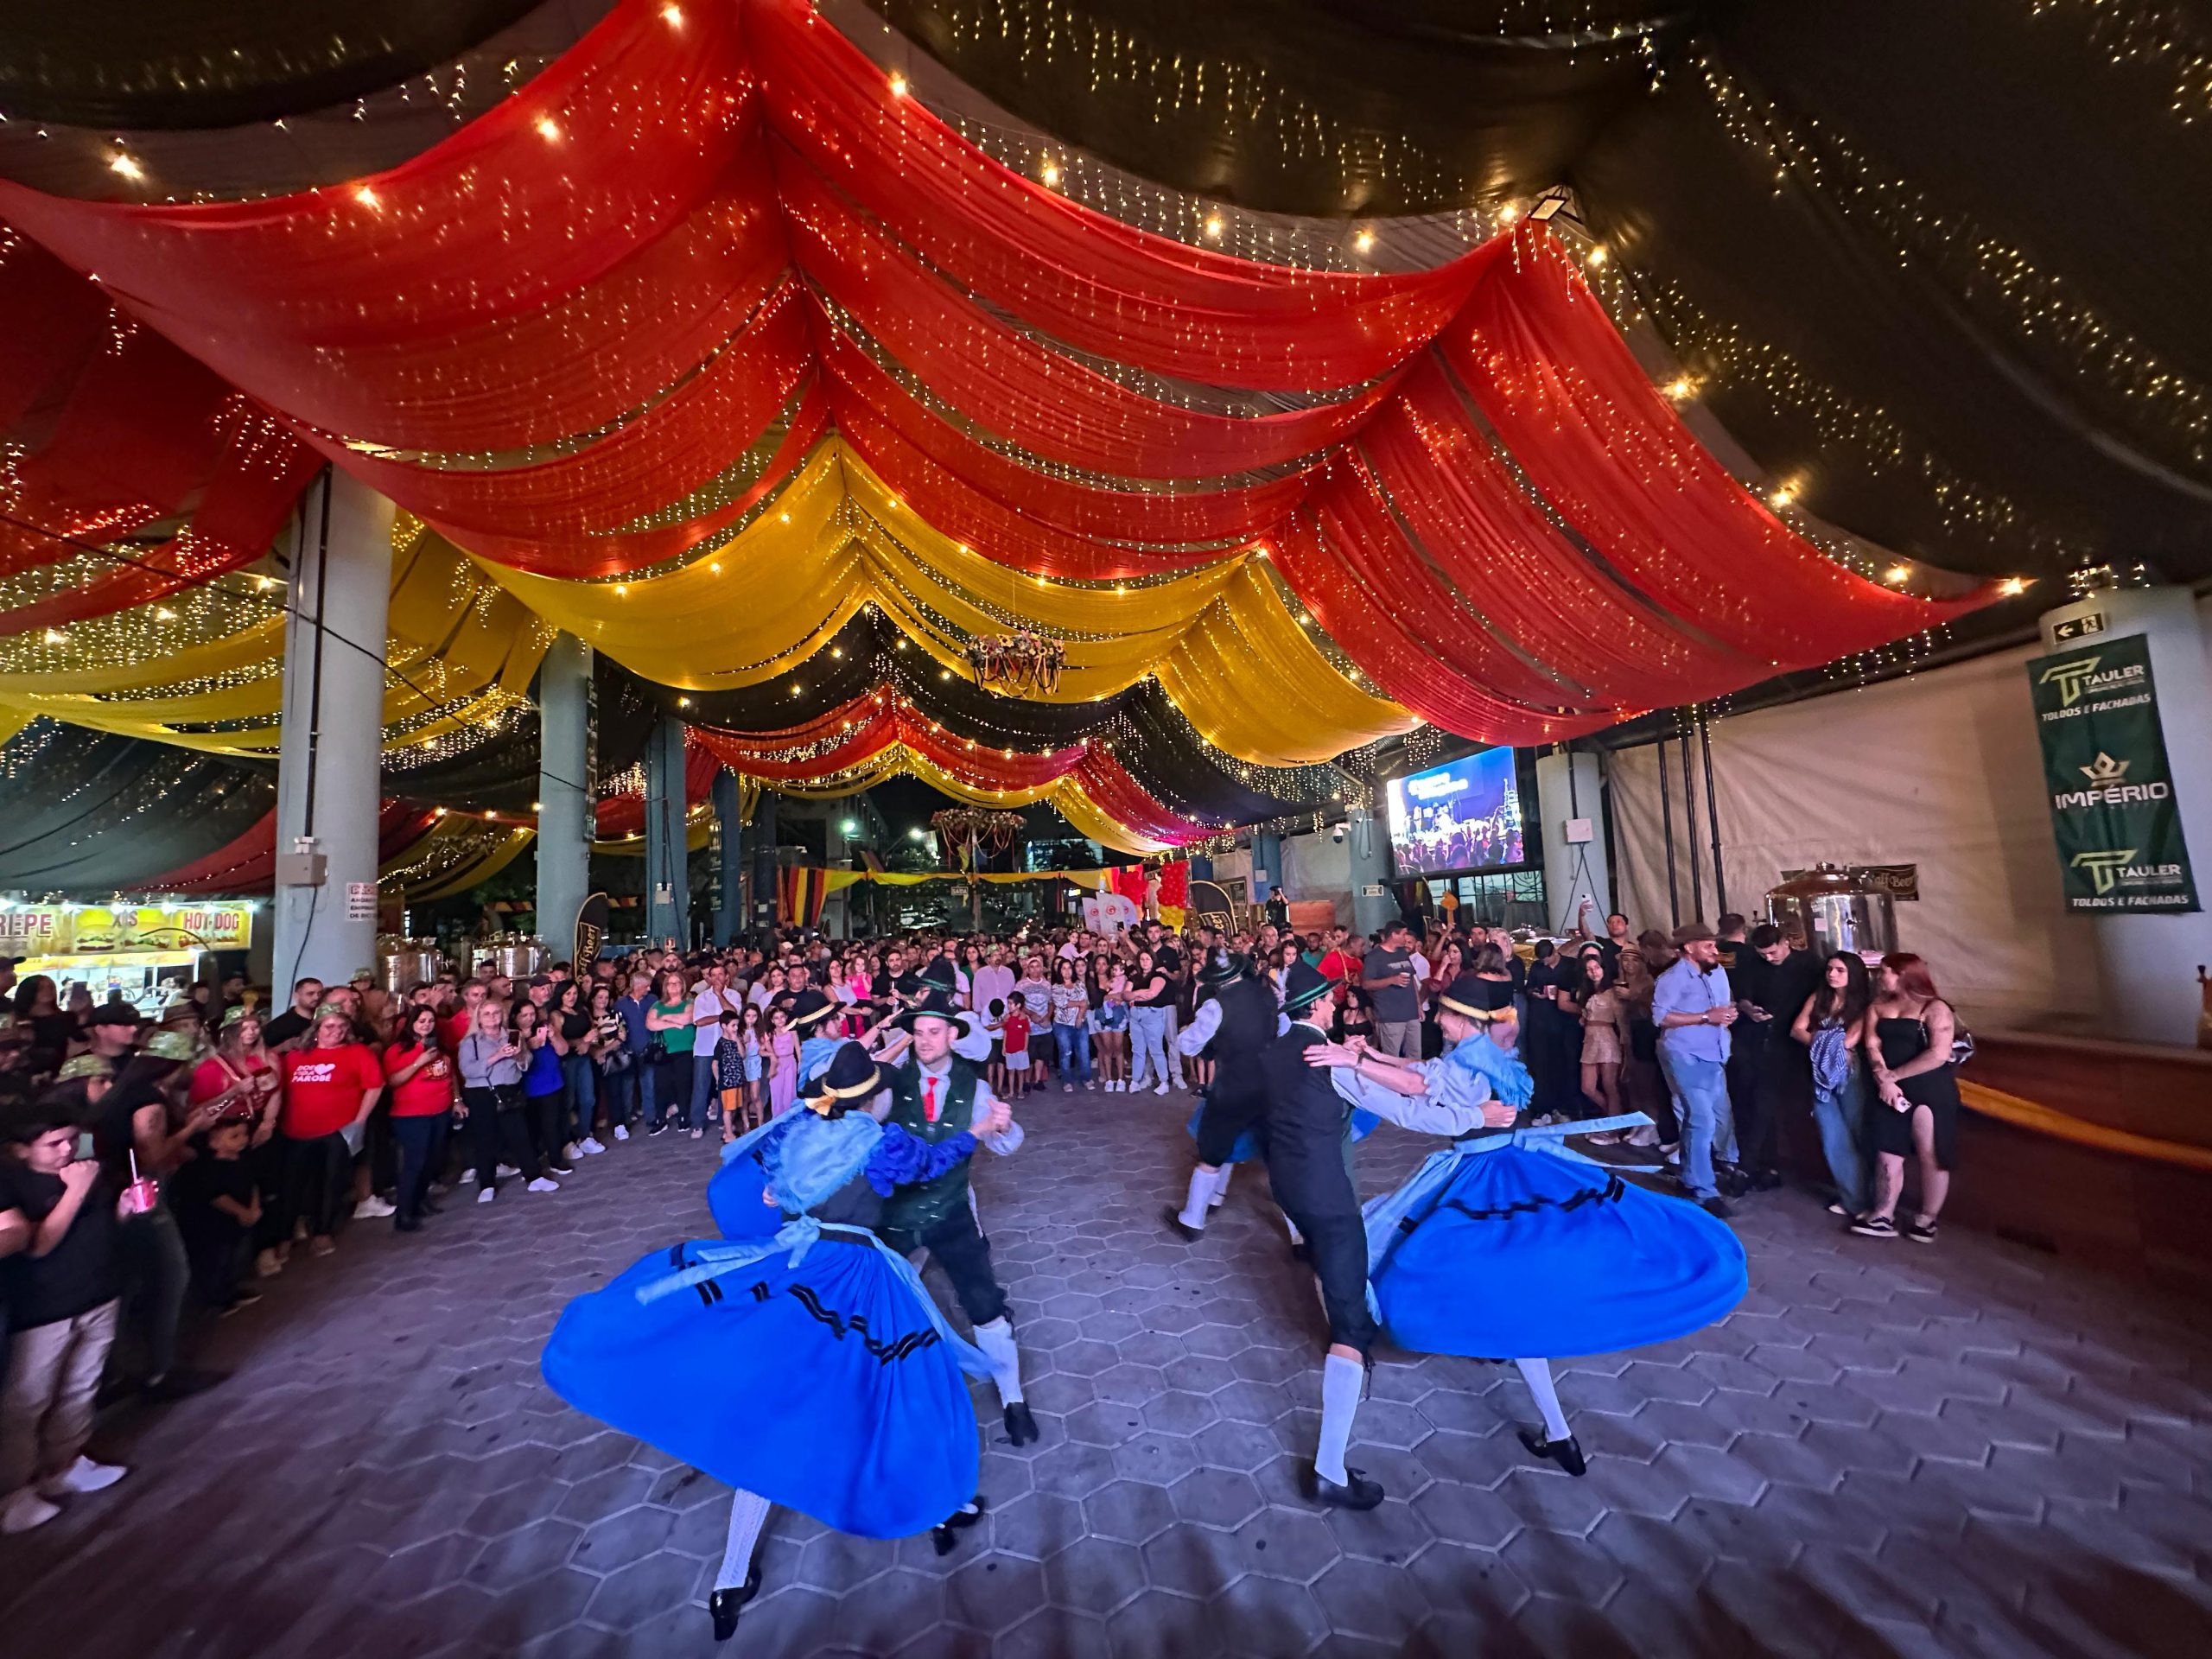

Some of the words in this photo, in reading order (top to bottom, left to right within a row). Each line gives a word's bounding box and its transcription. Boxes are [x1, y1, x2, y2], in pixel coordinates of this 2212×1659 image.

[2082, 664, 2145, 686] TAULER
[2042, 707, 2081, 721] TOLDOS
[2084, 704, 2090, 714] E
[2093, 694, 2152, 713] FACHADAS
[2055, 782, 2170, 810] IMPÉRIO
[2117, 864, 2182, 878] TAULER
[2073, 897, 2115, 907] TOLDOS
[2127, 895, 2190, 906] FACHADAS
[583, 925, 595, 957] Beer
[292, 1073, 332, 1082] PAROBÉ
